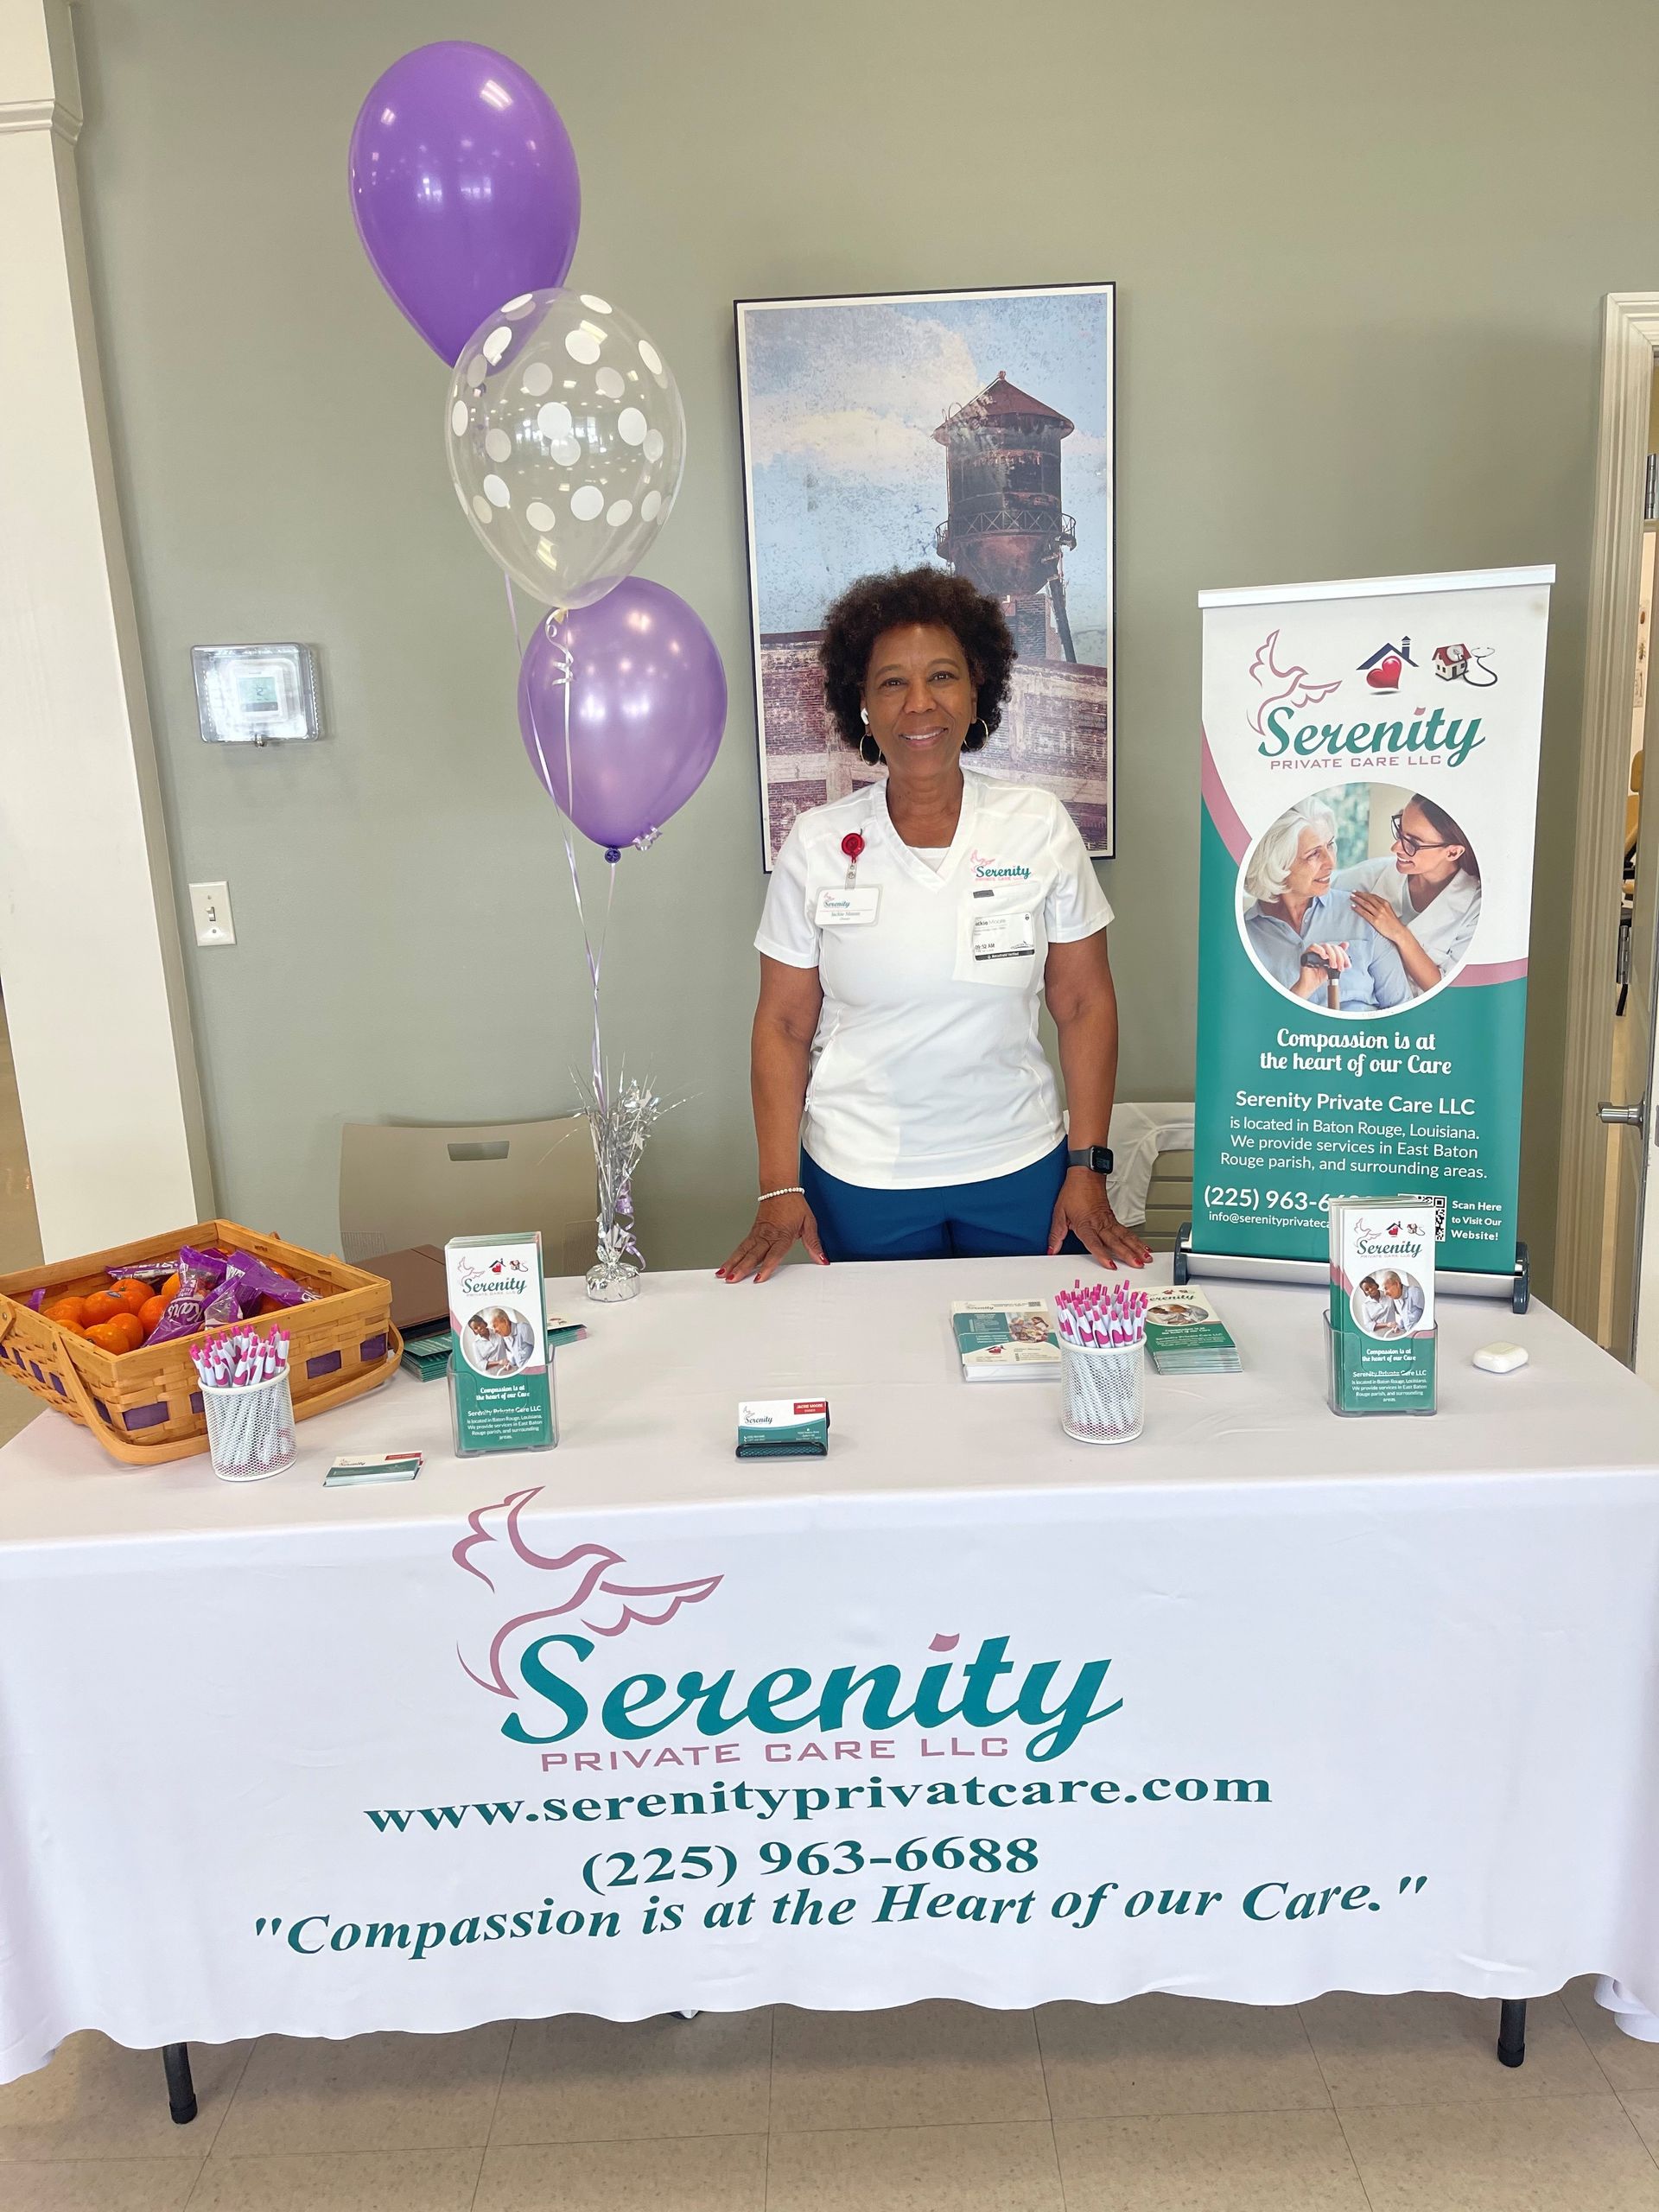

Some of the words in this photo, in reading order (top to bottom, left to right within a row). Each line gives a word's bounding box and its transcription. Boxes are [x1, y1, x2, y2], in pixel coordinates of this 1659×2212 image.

[1258, 706, 1486, 768] Serenity
[1270, 759, 1343, 771] PRIVATE
[1351, 756, 1400, 767] CARE
[1408, 755, 1442, 766] LLC
[976, 865, 1032, 880] Serenity
[1277, 1027, 1389, 1053] Compassion
[1394, 1031, 1410, 1050] is
[1415, 1033, 1436, 1051] at
[1260, 1052, 1287, 1070] the
[1293, 1052, 1343, 1071] heart
[1347, 1053, 1367, 1077] of
[1370, 1058, 1402, 1073] our
[1407, 1054, 1452, 1075] Care
[1236, 1090, 1313, 1112] Serenity
[1317, 1093, 1383, 1112] Private
[1389, 1096, 1433, 1114] Care
[1439, 1097, 1476, 1116] LLC
[1230, 1116, 1241, 1129] is
[1244, 1116, 1293, 1132] located
[1297, 1119, 1309, 1132] in
[1313, 1119, 1354, 1134] Baton
[1358, 1122, 1406, 1139] Rouge,
[1409, 1123, 1480, 1140] Louisiana.
[1230, 1135, 1255, 1147] We
[1259, 1137, 1313, 1151] provide
[1316, 1140, 1375, 1154] services
[1380, 1141, 1392, 1154] in
[1397, 1142, 1429, 1156] East
[1433, 1143, 1478, 1159] Baton
[1221, 1152, 1264, 1169] Rouge
[1268, 1155, 1315, 1171] parish,
[1319, 1158, 1346, 1171] and
[1350, 1161, 1440, 1179] surrounding
[1443, 1167, 1488, 1179] areas.
[1204, 1185, 1260, 1211] (225)
[1452, 1200, 1475, 1210] Scan
[1478, 1202, 1503, 1211] Here
[1209, 1211, 1330, 1229] info@serenityprivateca
[1463, 1216, 1483, 1225] Visit
[1484, 1217, 1503, 1226] Our
[1451, 1229, 1498, 1241] Website!
[1357, 1239, 1423, 1258] Serenity
[462, 1277, 527, 1294] Serenity
[500, 1633, 1123, 1763] Serenity
[541, 1743, 741, 1772] PRIVATE
[765, 1739, 895, 1763] CARE
[921, 1737, 1008, 1757] LLC
[363, 1776, 1273, 1833] www.serenityprivatcare.com
[582, 1845, 738, 1896] (225)
[759, 1836, 1039, 1876] 963-6688
[255, 1897, 621, 1961] "Compassion
[642, 1895, 684, 1935] is
[703, 1892, 756, 1929] at
[773, 1888, 856, 1926] the
[872, 1882, 1036, 1924] Heart
[1051, 1882, 1119, 1929] of
[1124, 1889, 1223, 1917] our
